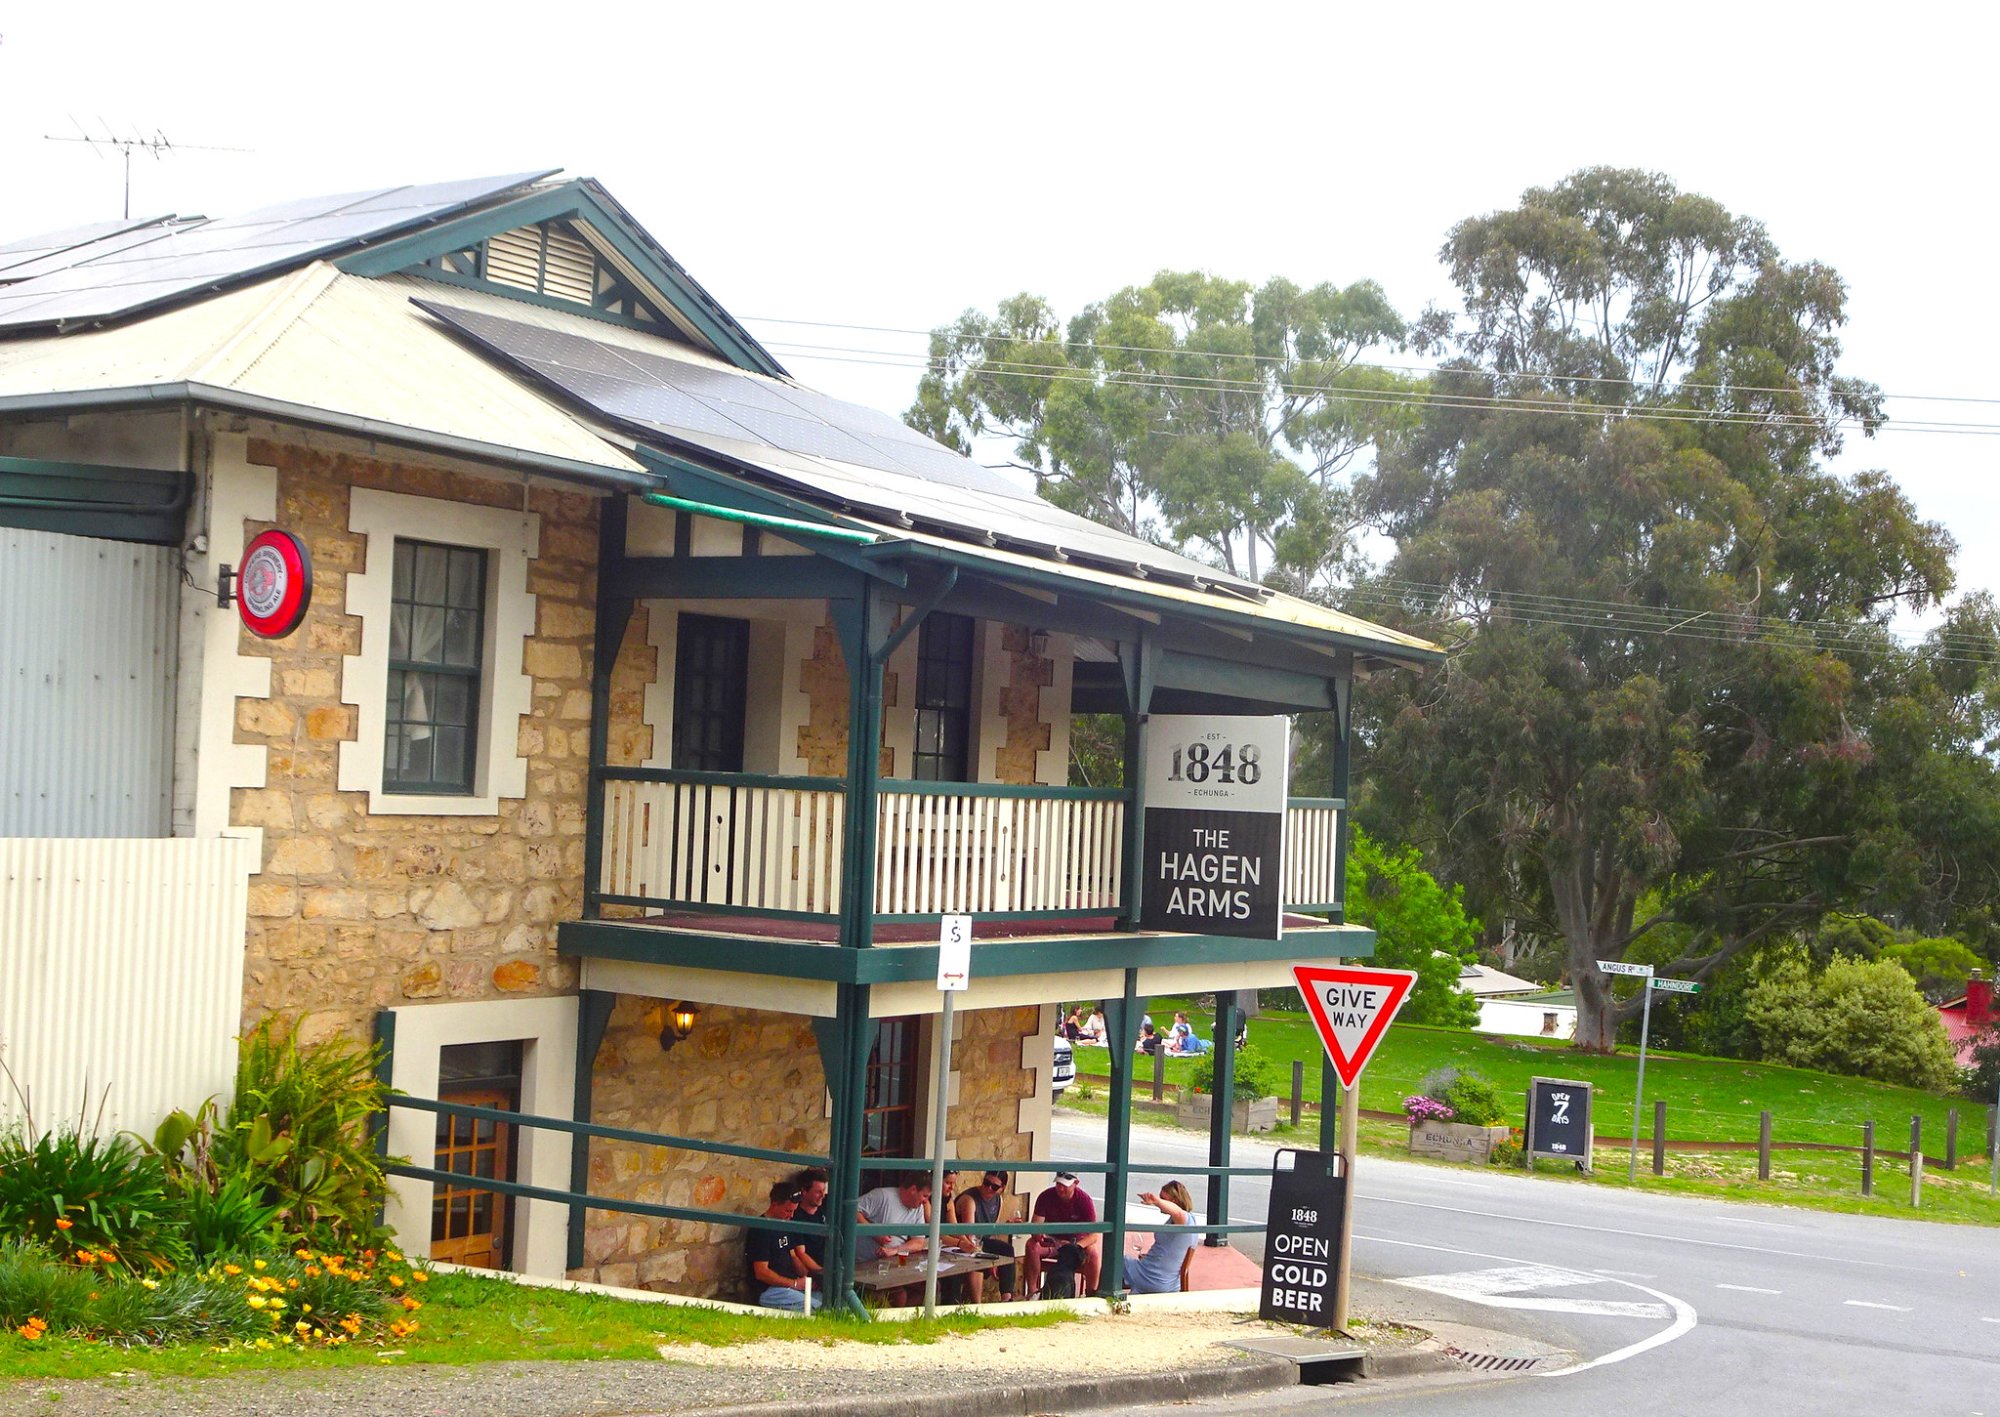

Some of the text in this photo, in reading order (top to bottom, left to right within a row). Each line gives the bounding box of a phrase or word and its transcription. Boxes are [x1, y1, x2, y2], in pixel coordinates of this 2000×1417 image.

[1167, 742, 1262, 785] 1848
[1192, 828, 1231, 849] THE
[1160, 851, 1261, 886] HAGEN
[1165, 886, 1251, 921] ARMS
[1602, 963, 1627, 974] ANGUS
[1326, 987, 1377, 1010] GIVE
[1332, 1011, 1368, 1029] WAY
[1551, 1092, 1571, 1101] OPEN
[1551, 1113, 1570, 1125] DAYS
[1553, 1100, 1570, 1118] 7
[1291, 1208, 1318, 1223] 1848
[1274, 1233, 1330, 1259] OPEN
[1271, 1263, 1328, 1288] COLD
[1271, 1287, 1323, 1313] BEER
